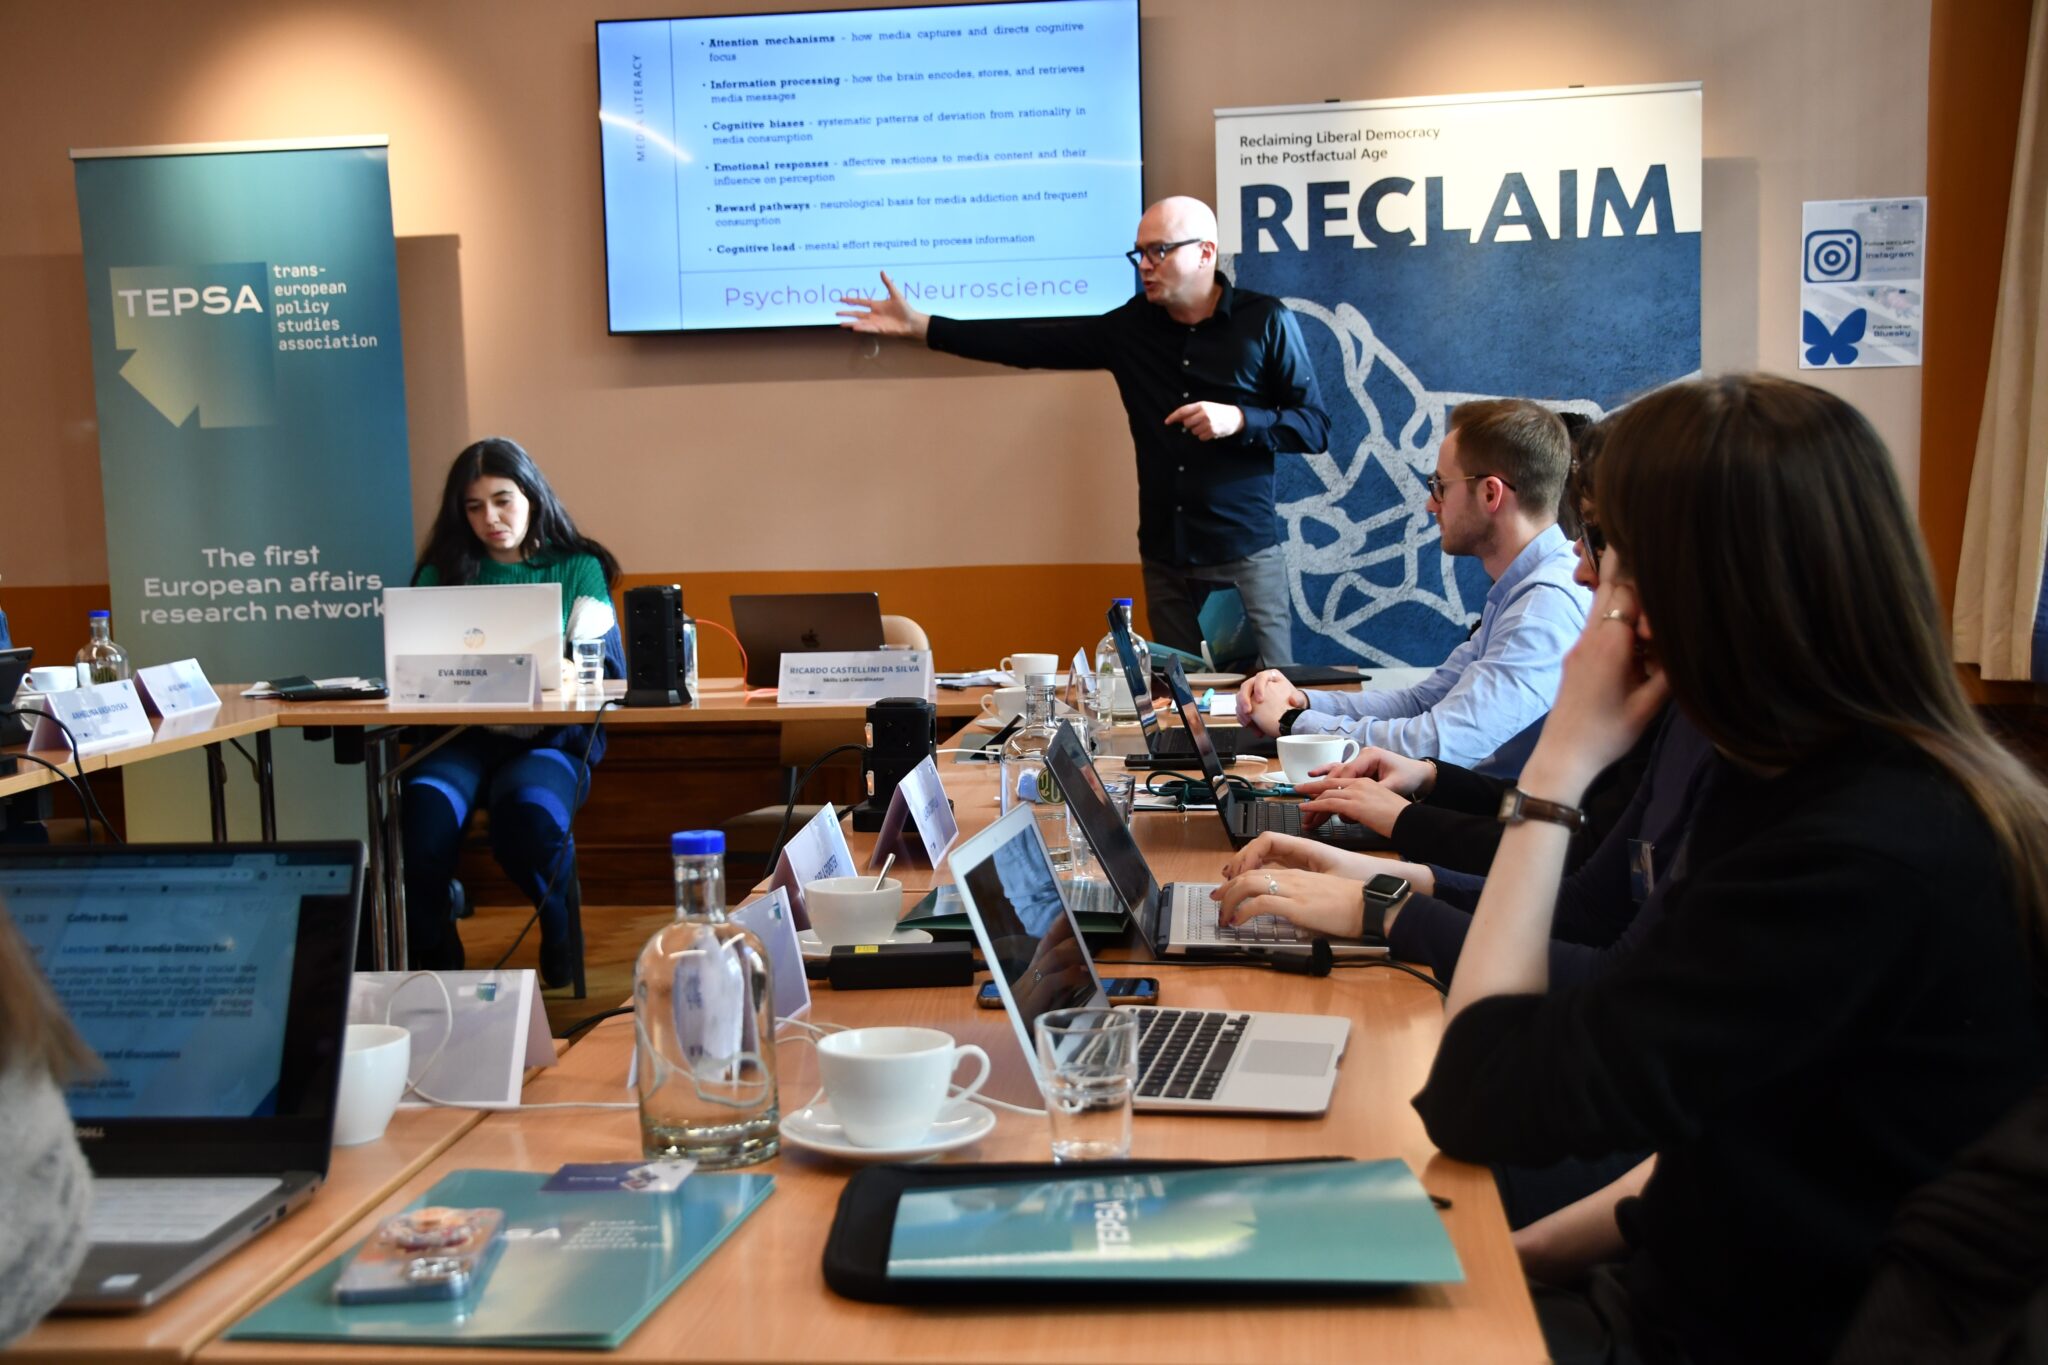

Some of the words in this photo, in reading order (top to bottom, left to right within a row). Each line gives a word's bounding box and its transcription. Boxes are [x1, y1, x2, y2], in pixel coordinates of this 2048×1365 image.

[709, 37, 759, 48] Attention
[765, 34, 835, 46] mechanisms
[851, 32, 873, 42] how
[878, 30, 911, 41] media
[917, 28, 962, 40] captures
[968, 26, 987, 37] and
[993, 24, 1029, 36] directs
[1035, 21, 1084, 35] cognitive
[709, 52, 737, 62] focus
[632, 54, 645, 114] LITERACY
[710, 79, 776, 90] Information
[780, 75, 841, 89] processing
[852, 74, 873, 84] how
[876, 73, 893, 83] the
[896, 71, 924, 82] brain
[928, 69, 975, 81] encodes,
[1015, 66, 1035, 76] and
[1038, 63, 1085, 75] retrieves
[711, 92, 742, 104] media
[746, 91, 796, 103] messages
[712, 120, 765, 132] Cognitive
[769, 118, 804, 129] biases
[817, 115, 871, 128] systematic
[876, 113, 919, 126] patterns
[923, 112, 934, 123] of
[937, 109, 986, 122] deviation
[990, 108, 1014, 119] from
[1018, 105, 1072, 119] rationality
[1075, 105, 1086, 116] in
[635, 118, 645, 162] MEDA
[713, 134, 744, 145] media
[747, 132, 813, 145] consumption
[1239, 131, 1312, 149] Reclaiming
[1316, 129, 1362, 144] Liberal
[1365, 126, 1441, 144] Democracy
[713, 161, 770, 172] Emotional
[774, 160, 829, 172] responses
[842, 157, 886, 167] affective
[890, 154, 938, 165] reactions
[942, 153, 953, 163] to
[957, 152, 990, 162] media
[994, 150, 1033, 161] content
[1038, 149, 1057, 159] and
[1062, 148, 1087, 158] their
[1239, 152, 1253, 166] in
[1256, 151, 1279, 165] the
[1282, 148, 1357, 163] Postfactual
[1361, 148, 1388, 164] Age
[714, 175, 761, 186] influence
[764, 175, 777, 184] on
[779, 173, 836, 185] perception
[715, 202, 756, 213] Reward
[759, 201, 810, 214] pathways
[820, 198, 885, 210] neurological
[887, 197, 914, 207] basis
[916, 195, 931, 206] for
[934, 194, 967, 204] media
[970, 192, 1019, 203] addiction
[1021, 191, 1041, 201] and
[1043, 189, 1088, 202] frequent
[1239, 163, 1676, 253] RECLAIM
[715, 216, 781, 228] consumption
[716, 243, 769, 255] Cognitive
[772, 242, 795, 252] load
[805, 241, 839, 251] mental
[842, 240, 870, 250] effort
[872, 238, 917, 250] required
[920, 237, 930, 247] to
[932, 236, 973, 248] process
[975, 233, 1036, 245] information
[1865, 251, 1915, 260] Instagram
[273, 264, 326, 279] trans-
[274, 281, 347, 297] european
[903, 276, 1089, 301] Neuroscience
[117, 284, 264, 318] TEPSA
[276, 300, 329, 317] policy
[277, 318, 340, 333] studies
[1873, 329, 1911, 338] Bluesky
[278, 335, 378, 351] association
[201, 547, 256, 568] The
[264, 545, 320, 567] first
[144, 577, 282, 600] European
[290, 570, 383, 592] affairs
[140, 601, 267, 624] research
[275, 597, 385, 620] network
[437, 669, 455, 677] EVA
[456, 668, 488, 677] RIBERA
[790, 665, 829, 675] RICARDO
[830, 665, 880, 674] CASTELLINI
[881, 665, 893, 673] DA
[895, 665, 920, 673] SILVA
[66, 912, 98, 923] Coffee
[100, 912, 129, 923] Break
[142, 944, 172, 954] media
